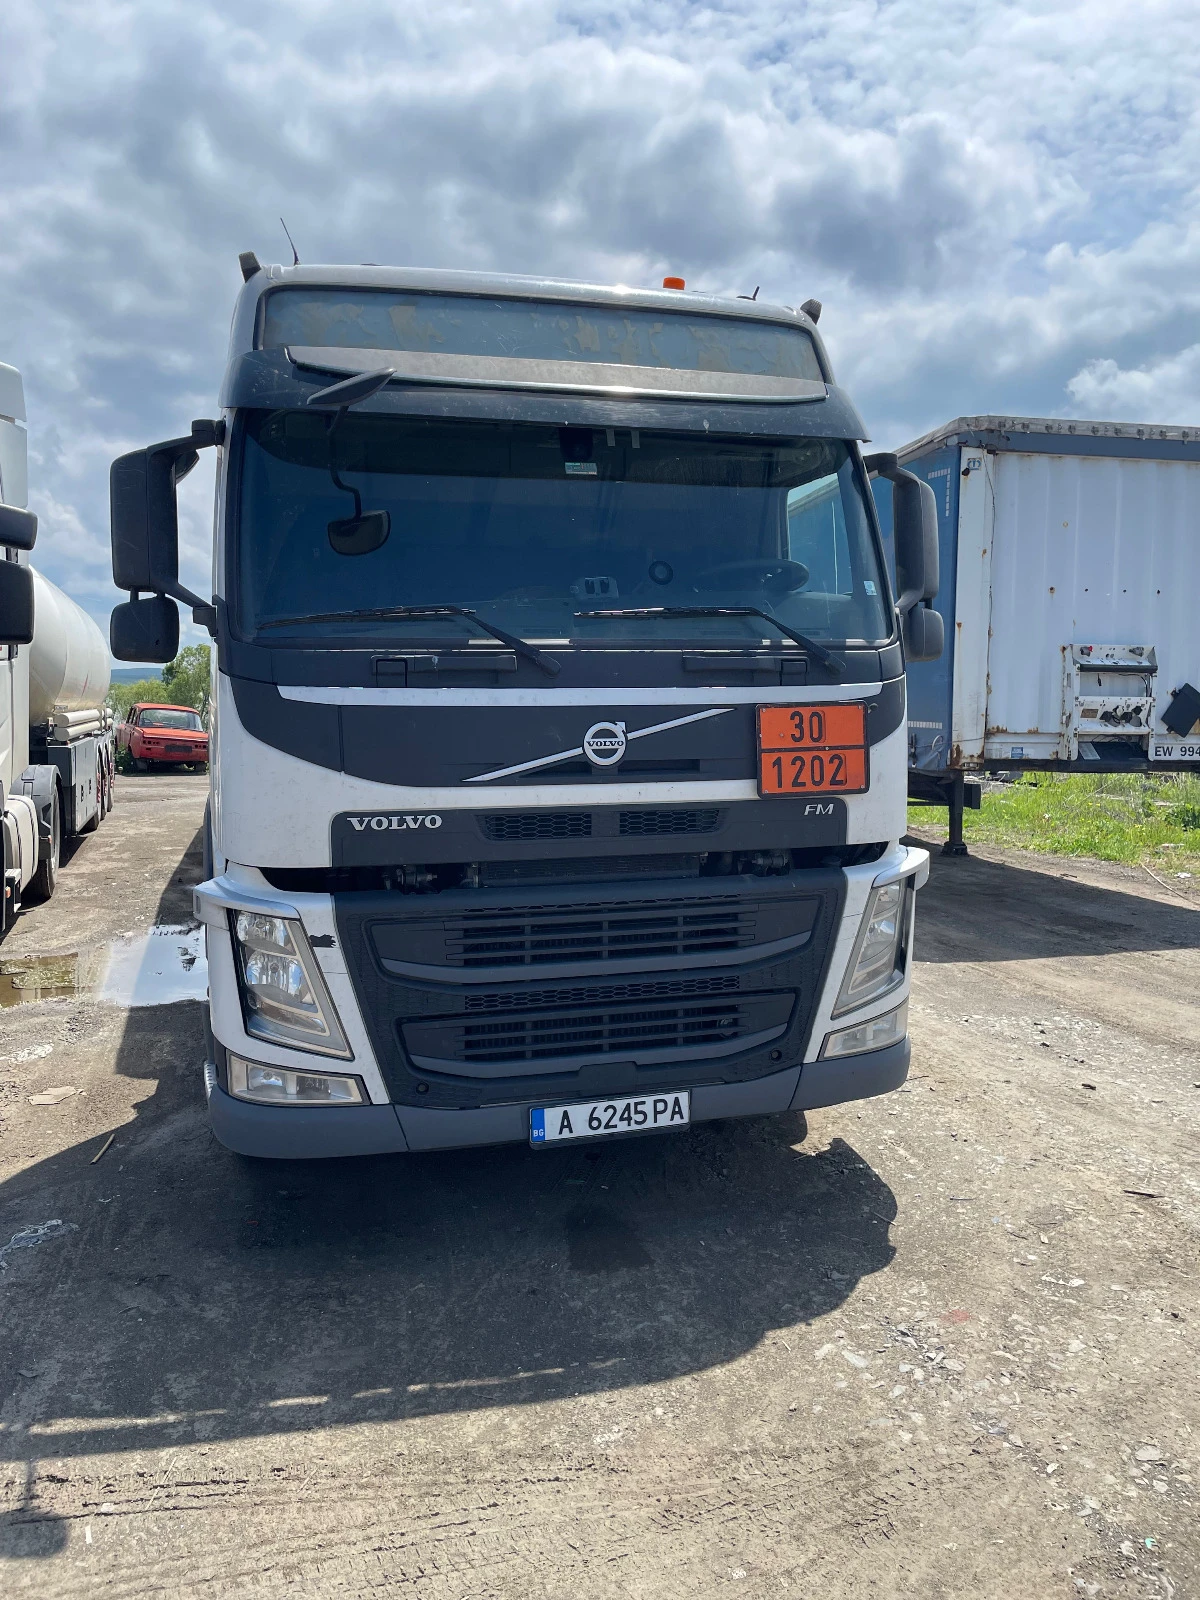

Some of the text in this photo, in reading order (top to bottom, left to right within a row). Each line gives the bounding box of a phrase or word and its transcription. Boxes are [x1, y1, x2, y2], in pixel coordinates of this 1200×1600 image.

[790, 711, 823, 743] 30
[1154, 746, 1174, 757] EW
[772, 753, 844, 789] 1202
[804, 803, 834, 816] FM
[346, 814, 442, 831] VOLVO
[558, 1109, 573, 1135] A
[533, 1128, 544, 1137] BG
